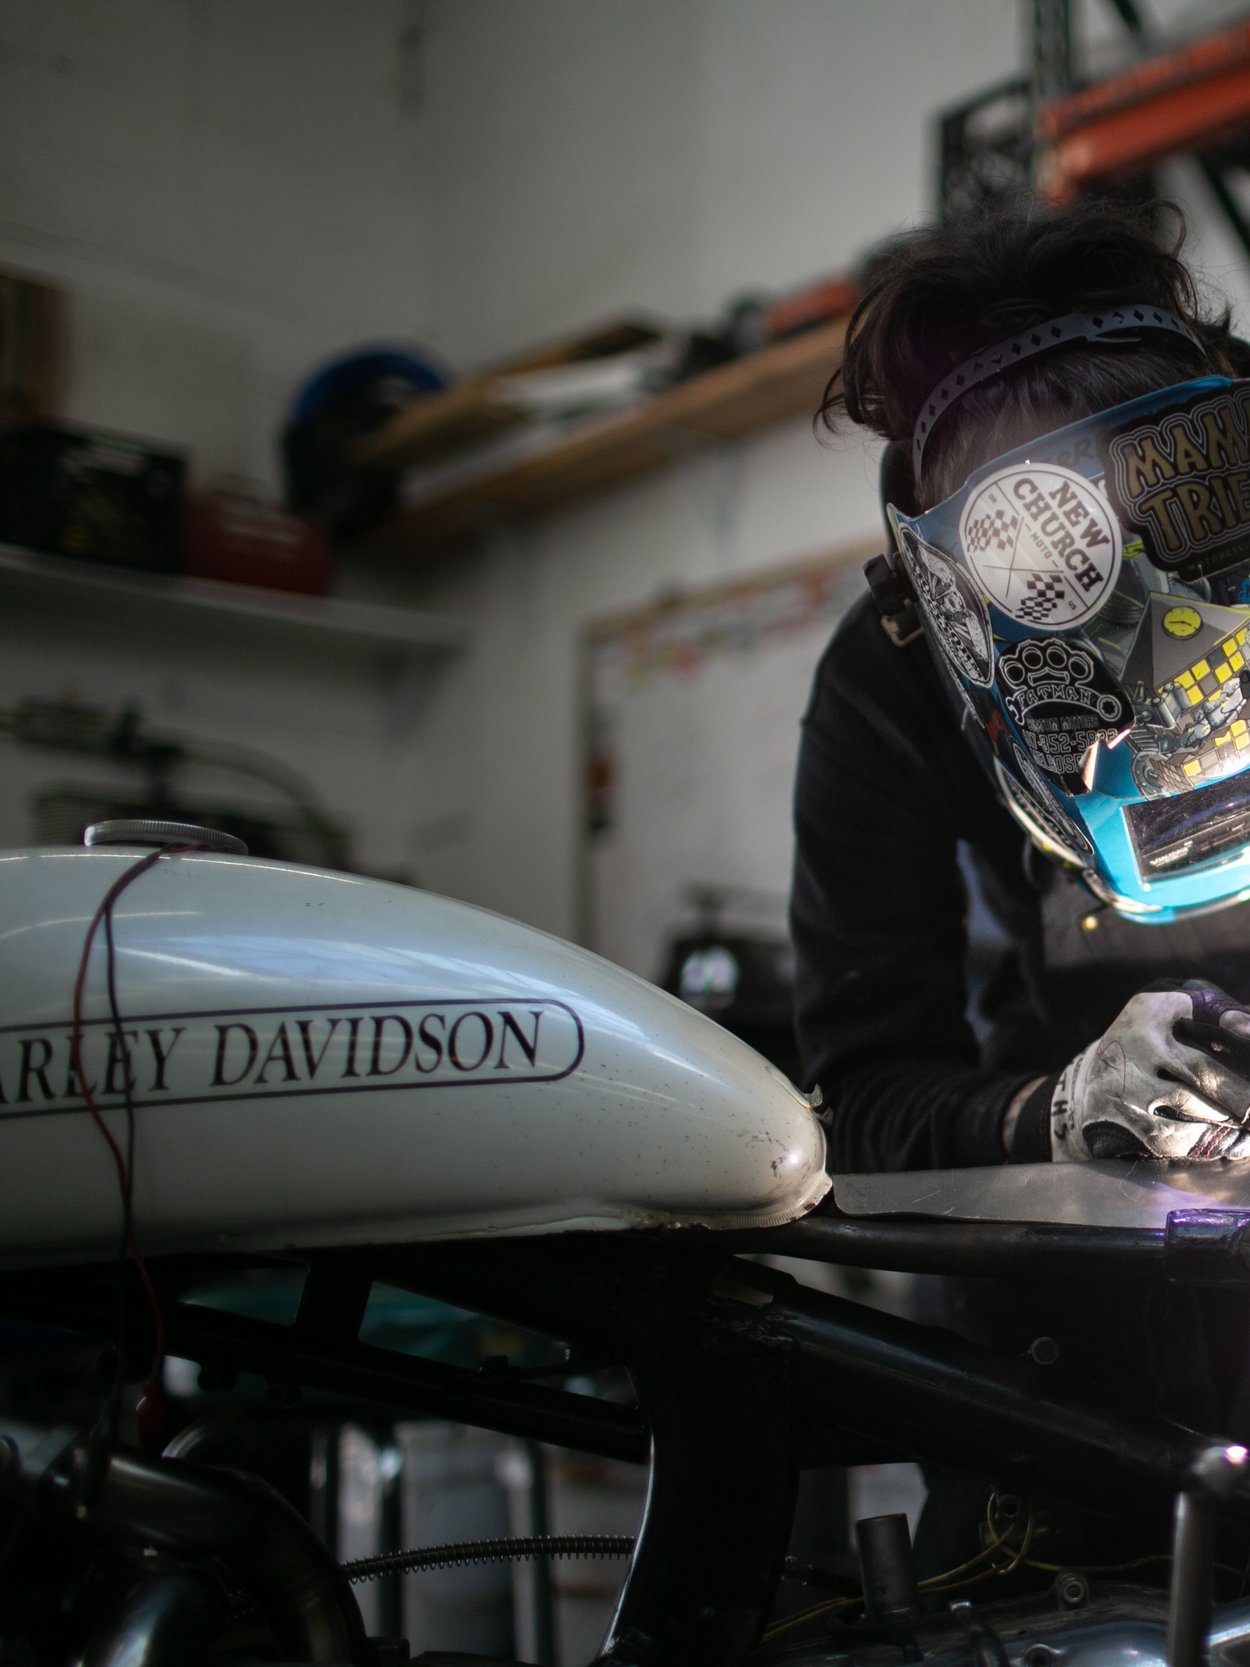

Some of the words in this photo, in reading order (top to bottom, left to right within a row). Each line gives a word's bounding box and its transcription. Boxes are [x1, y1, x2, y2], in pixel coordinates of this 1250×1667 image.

[1013, 477, 1105, 592] CHURCH
[1030, 532, 1053, 559] MOTO
[1049, 480, 1110, 548] NEW
[1015, 684, 1092, 711] FATMAN
[0, 1025, 187, 1104] RLEY
[209, 1009, 546, 1087] DAVIDSON
